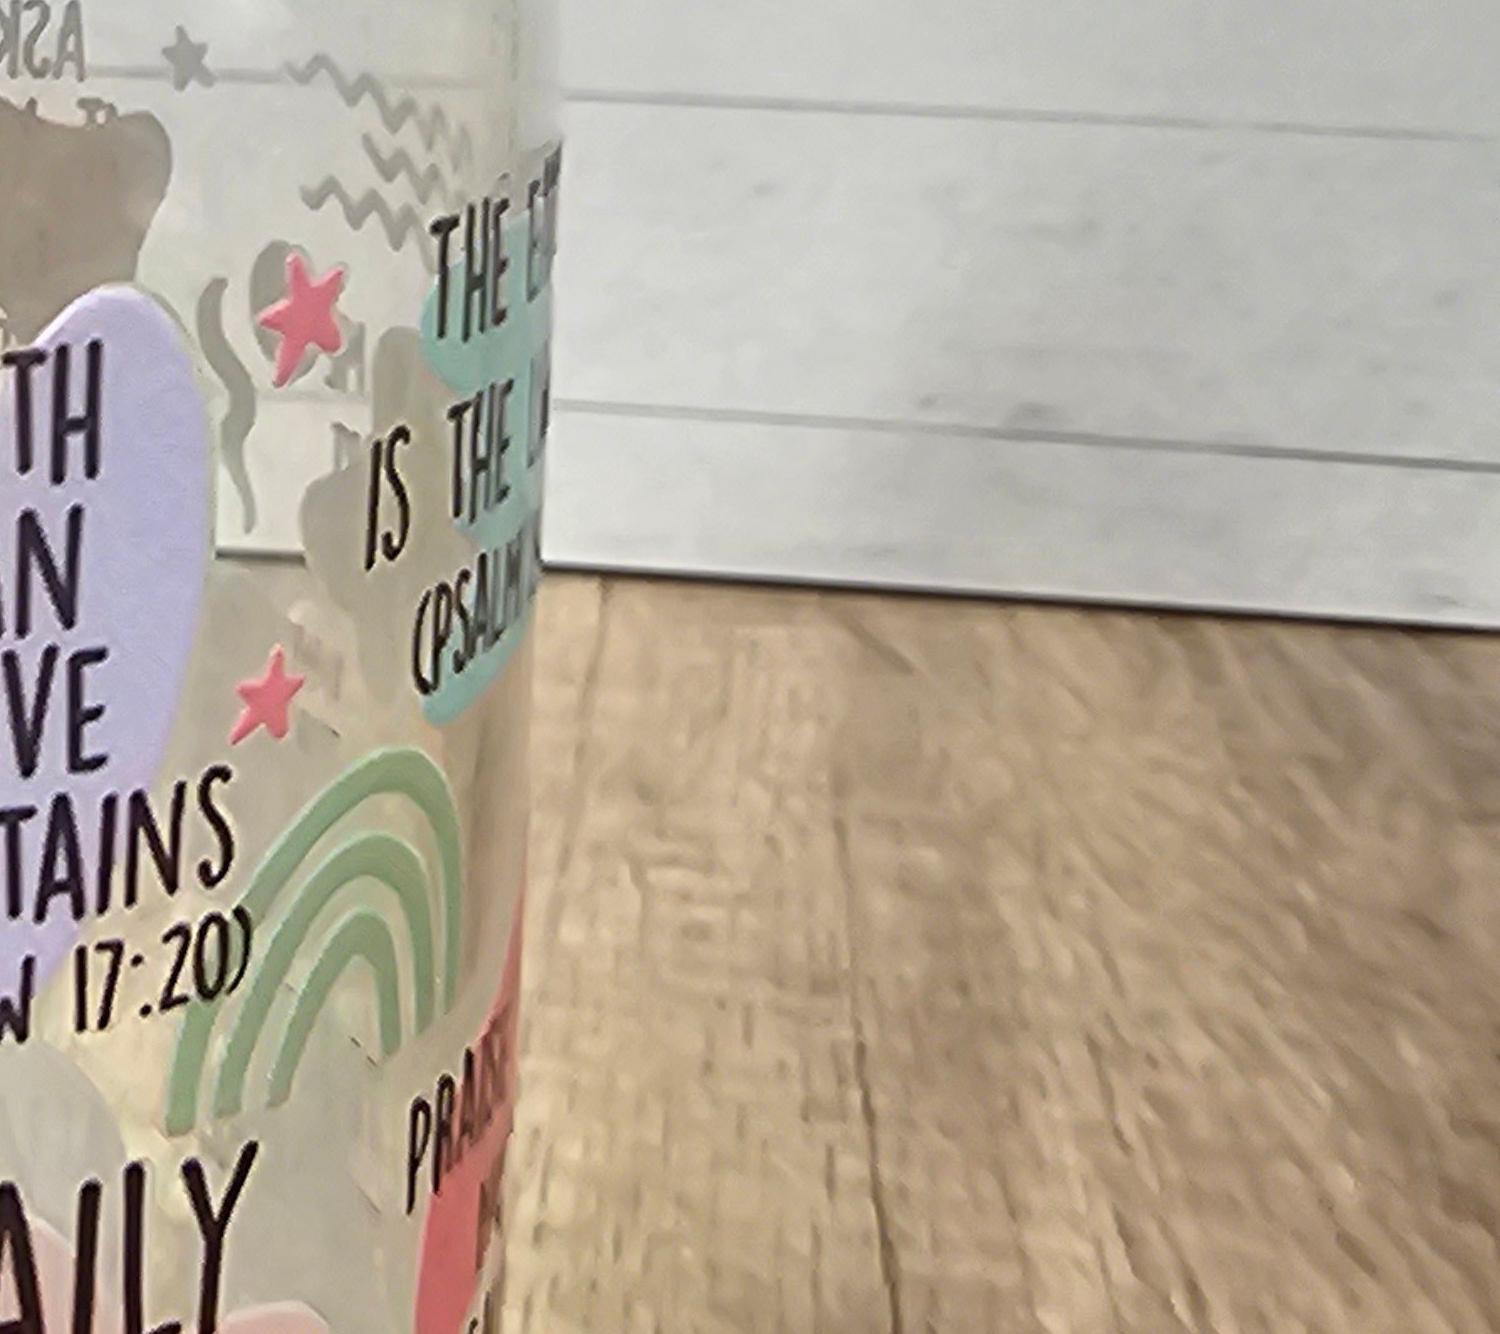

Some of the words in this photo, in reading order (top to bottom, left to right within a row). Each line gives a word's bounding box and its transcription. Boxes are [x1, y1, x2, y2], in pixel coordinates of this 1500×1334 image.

[430, 197, 510, 343] THE
[364, 424, 411, 572] IS
[445, 378, 515, 524] THE
[73, 905, 252, 1035] 17:20)
